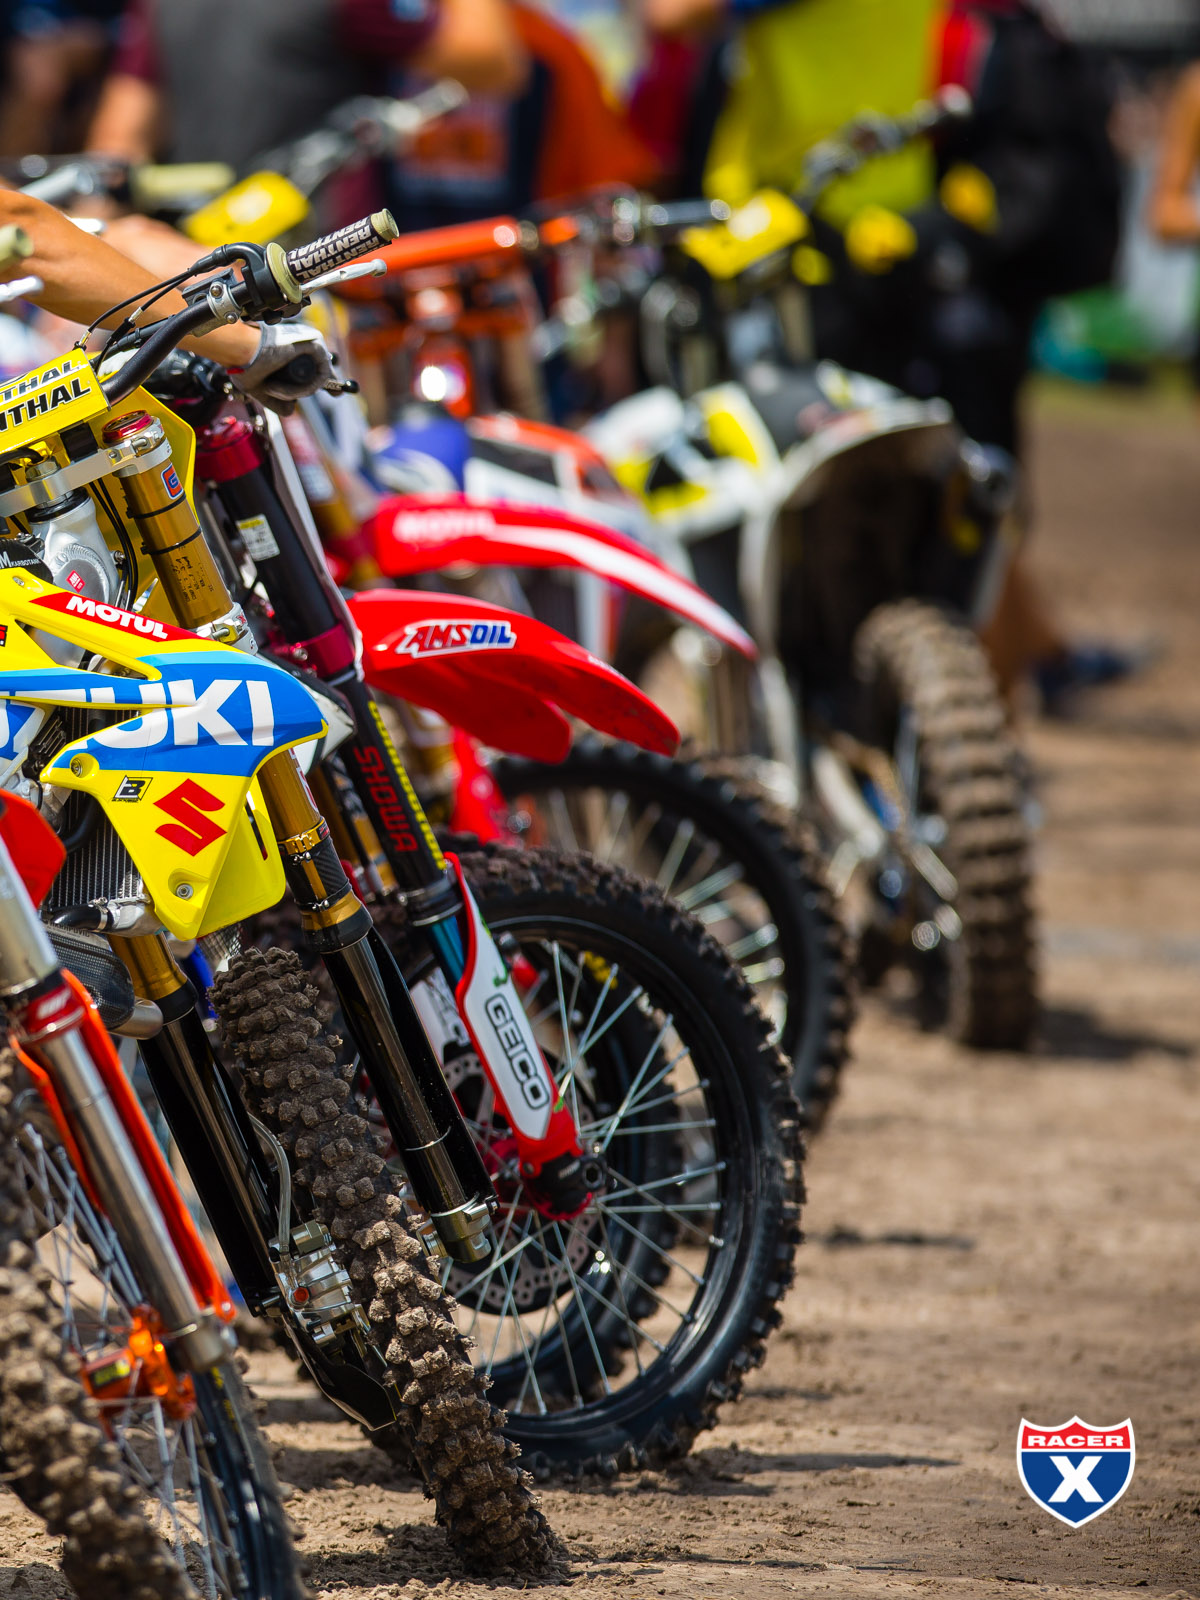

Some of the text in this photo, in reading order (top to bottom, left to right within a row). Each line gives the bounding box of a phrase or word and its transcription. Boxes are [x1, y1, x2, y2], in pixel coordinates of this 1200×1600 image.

[290, 225, 372, 271] RENTHAL
[296, 236, 380, 279] RENTHAL
[66, 596, 168, 639] MOTUL
[400, 621, 515, 657] AMSOIL
[353, 745, 419, 852] SHOWA
[485, 994, 550, 1110] GEICO
